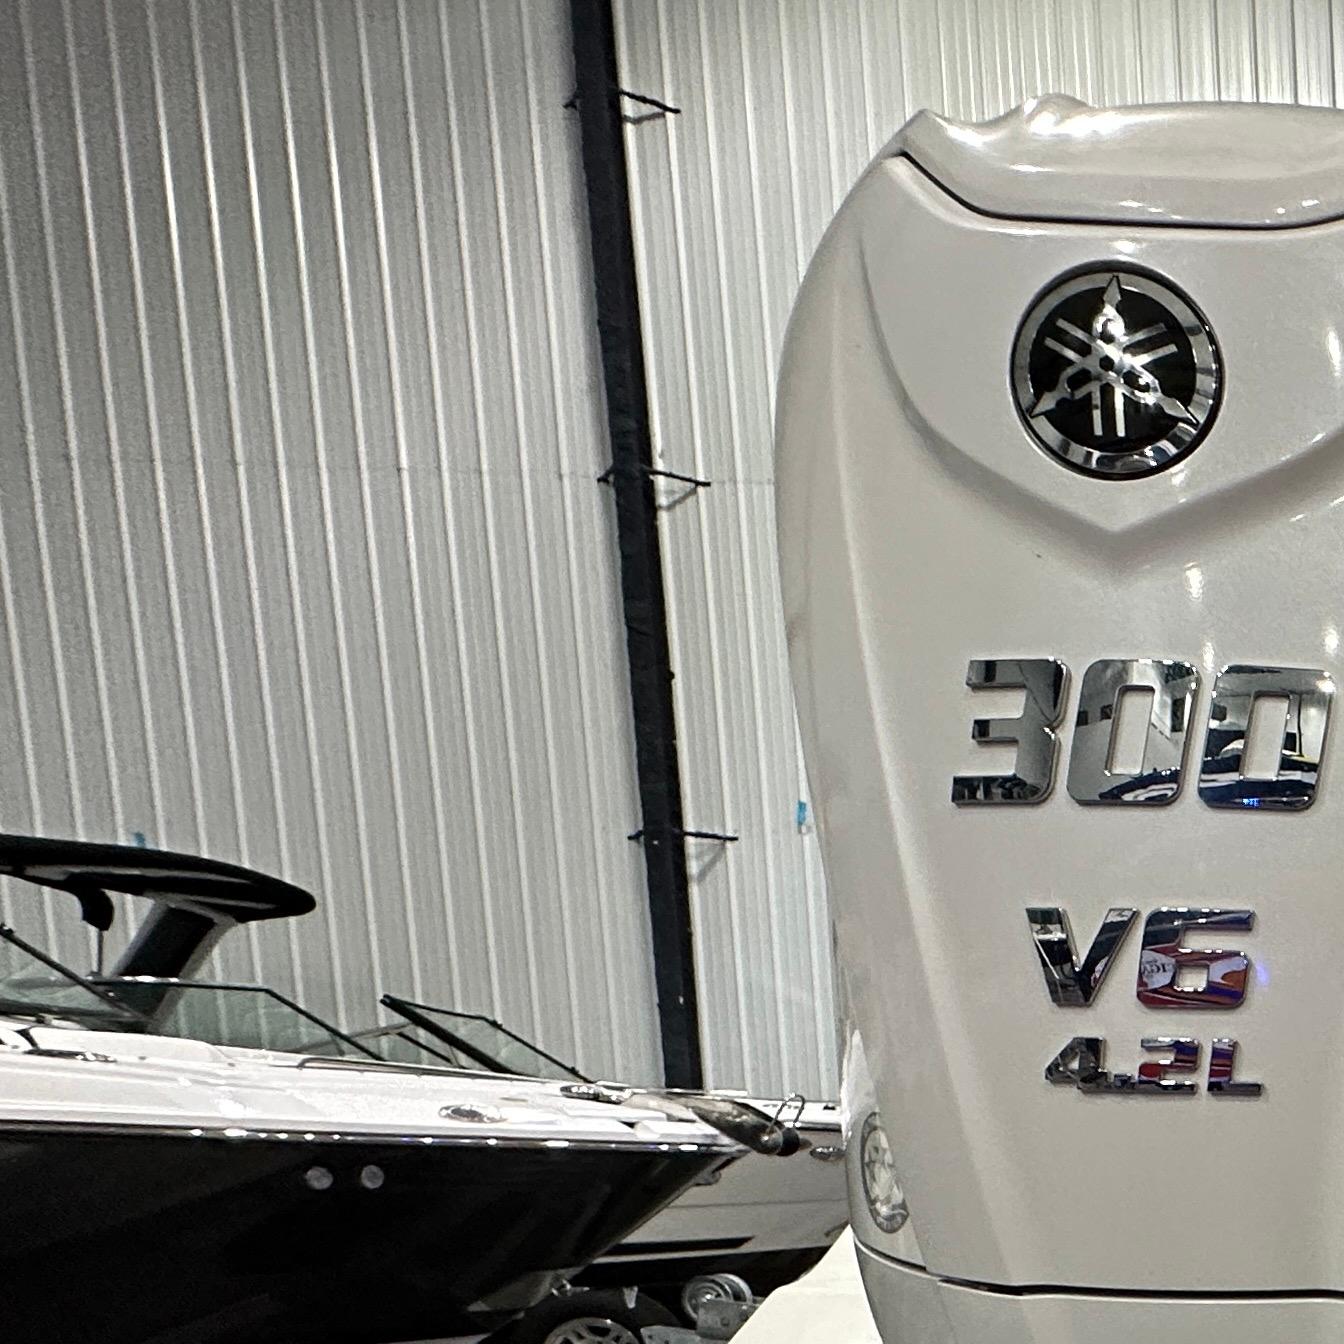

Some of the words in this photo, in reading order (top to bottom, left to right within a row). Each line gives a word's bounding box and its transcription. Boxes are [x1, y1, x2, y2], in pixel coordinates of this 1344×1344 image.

[951, 657, 1336, 812] 300
[1024, 906, 1257, 1011] V6
[1044, 1036, 1265, 1097] 4.2L
